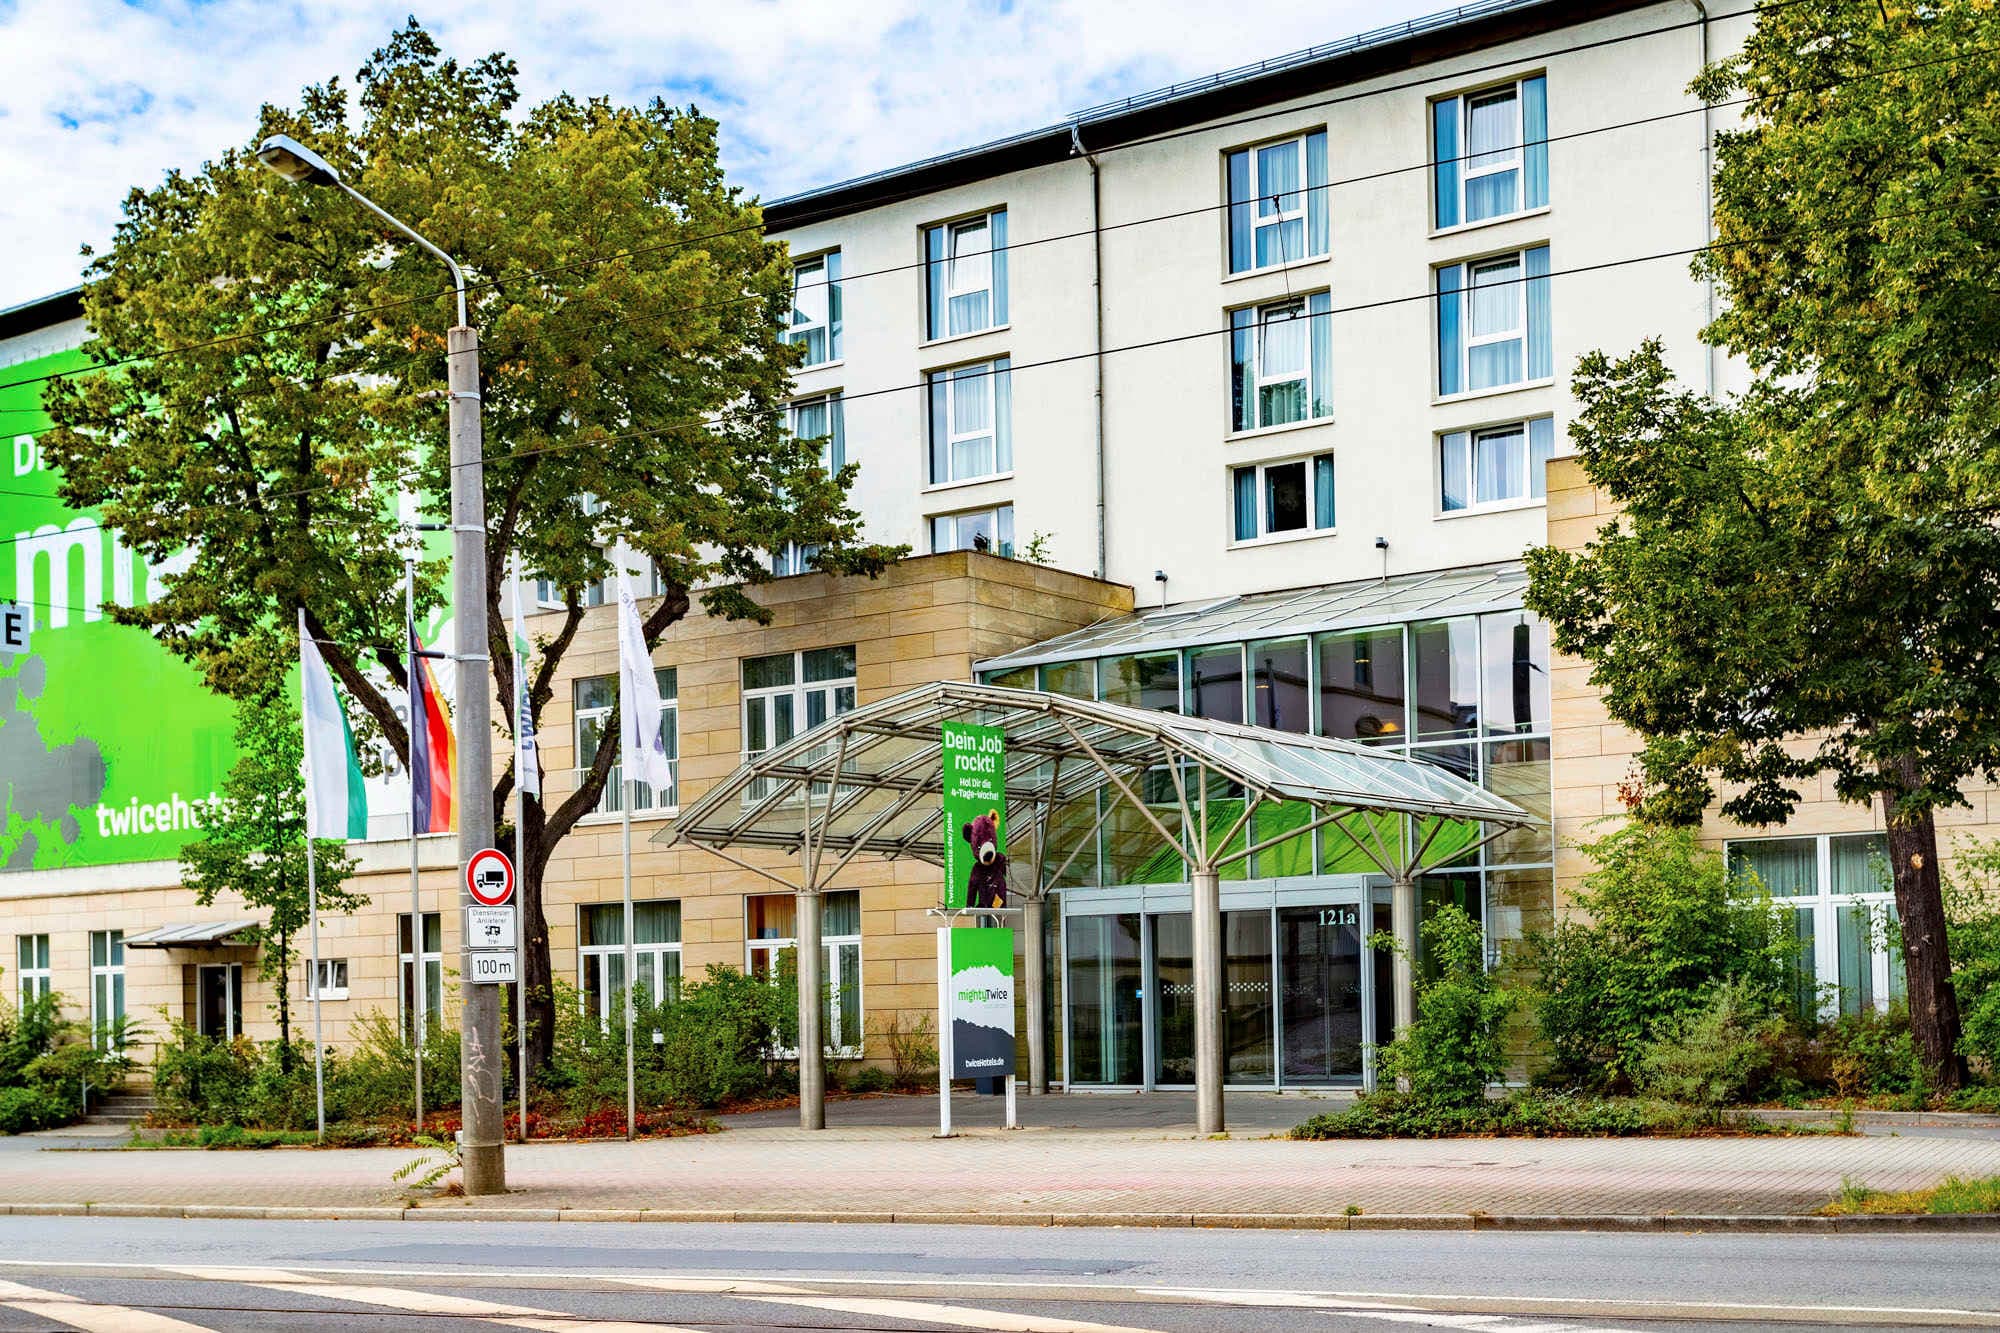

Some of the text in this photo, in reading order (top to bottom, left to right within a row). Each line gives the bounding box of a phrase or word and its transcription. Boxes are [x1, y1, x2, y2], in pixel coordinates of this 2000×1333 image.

[5, 612, 23, 646] E
[945, 730, 1003, 754] Dein Job
[955, 752, 996, 773] rockt!
[1319, 908, 1356, 926] 121a
[477, 959, 511, 975] 100 m
[958, 988, 1008, 1003] mightyTwice
